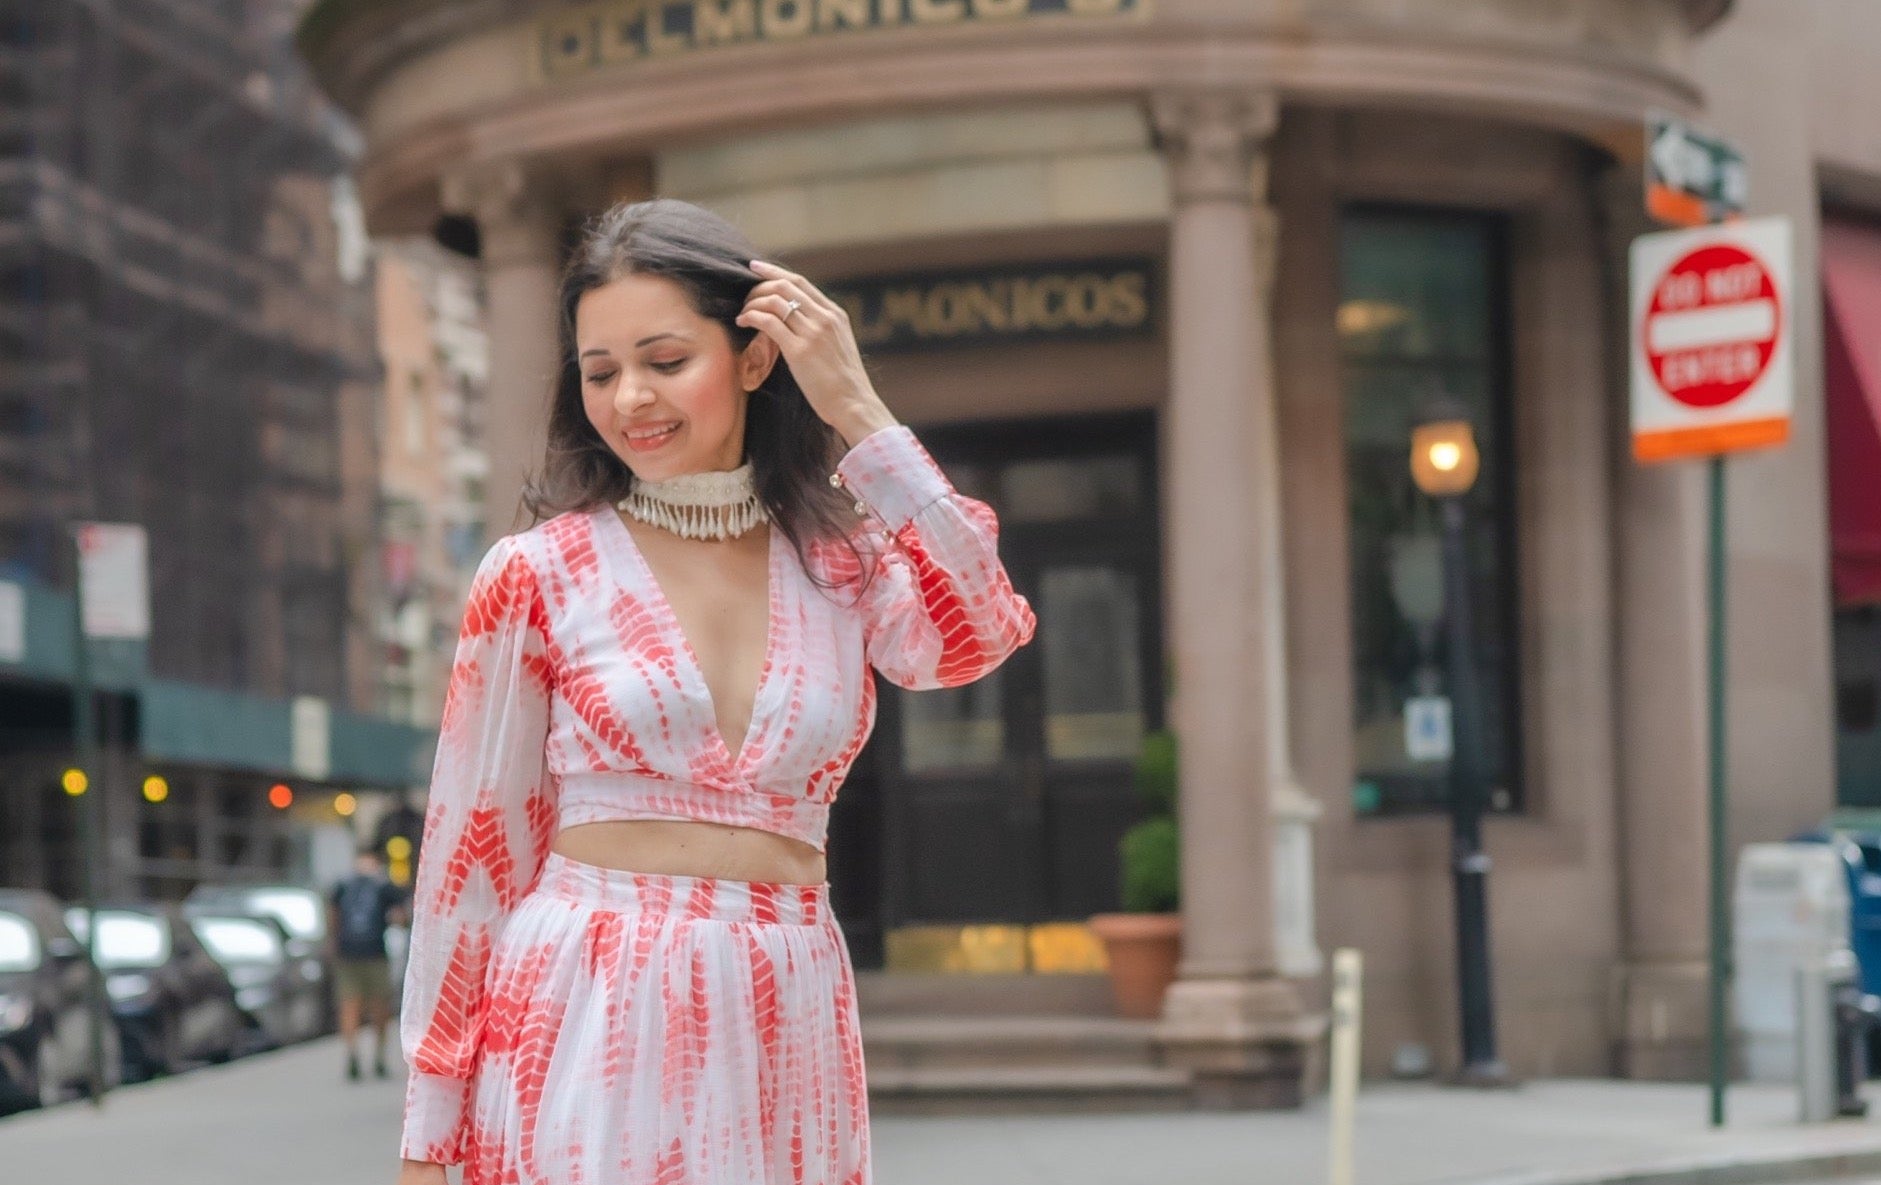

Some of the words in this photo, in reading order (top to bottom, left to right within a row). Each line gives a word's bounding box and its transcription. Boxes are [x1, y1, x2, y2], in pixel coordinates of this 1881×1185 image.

[548, 0, 1120, 66] DELMONI
[1658, 270, 1702, 310] DO
[1704, 262, 1762, 302] NOT
[1661, 344, 1761, 390] ENTER
